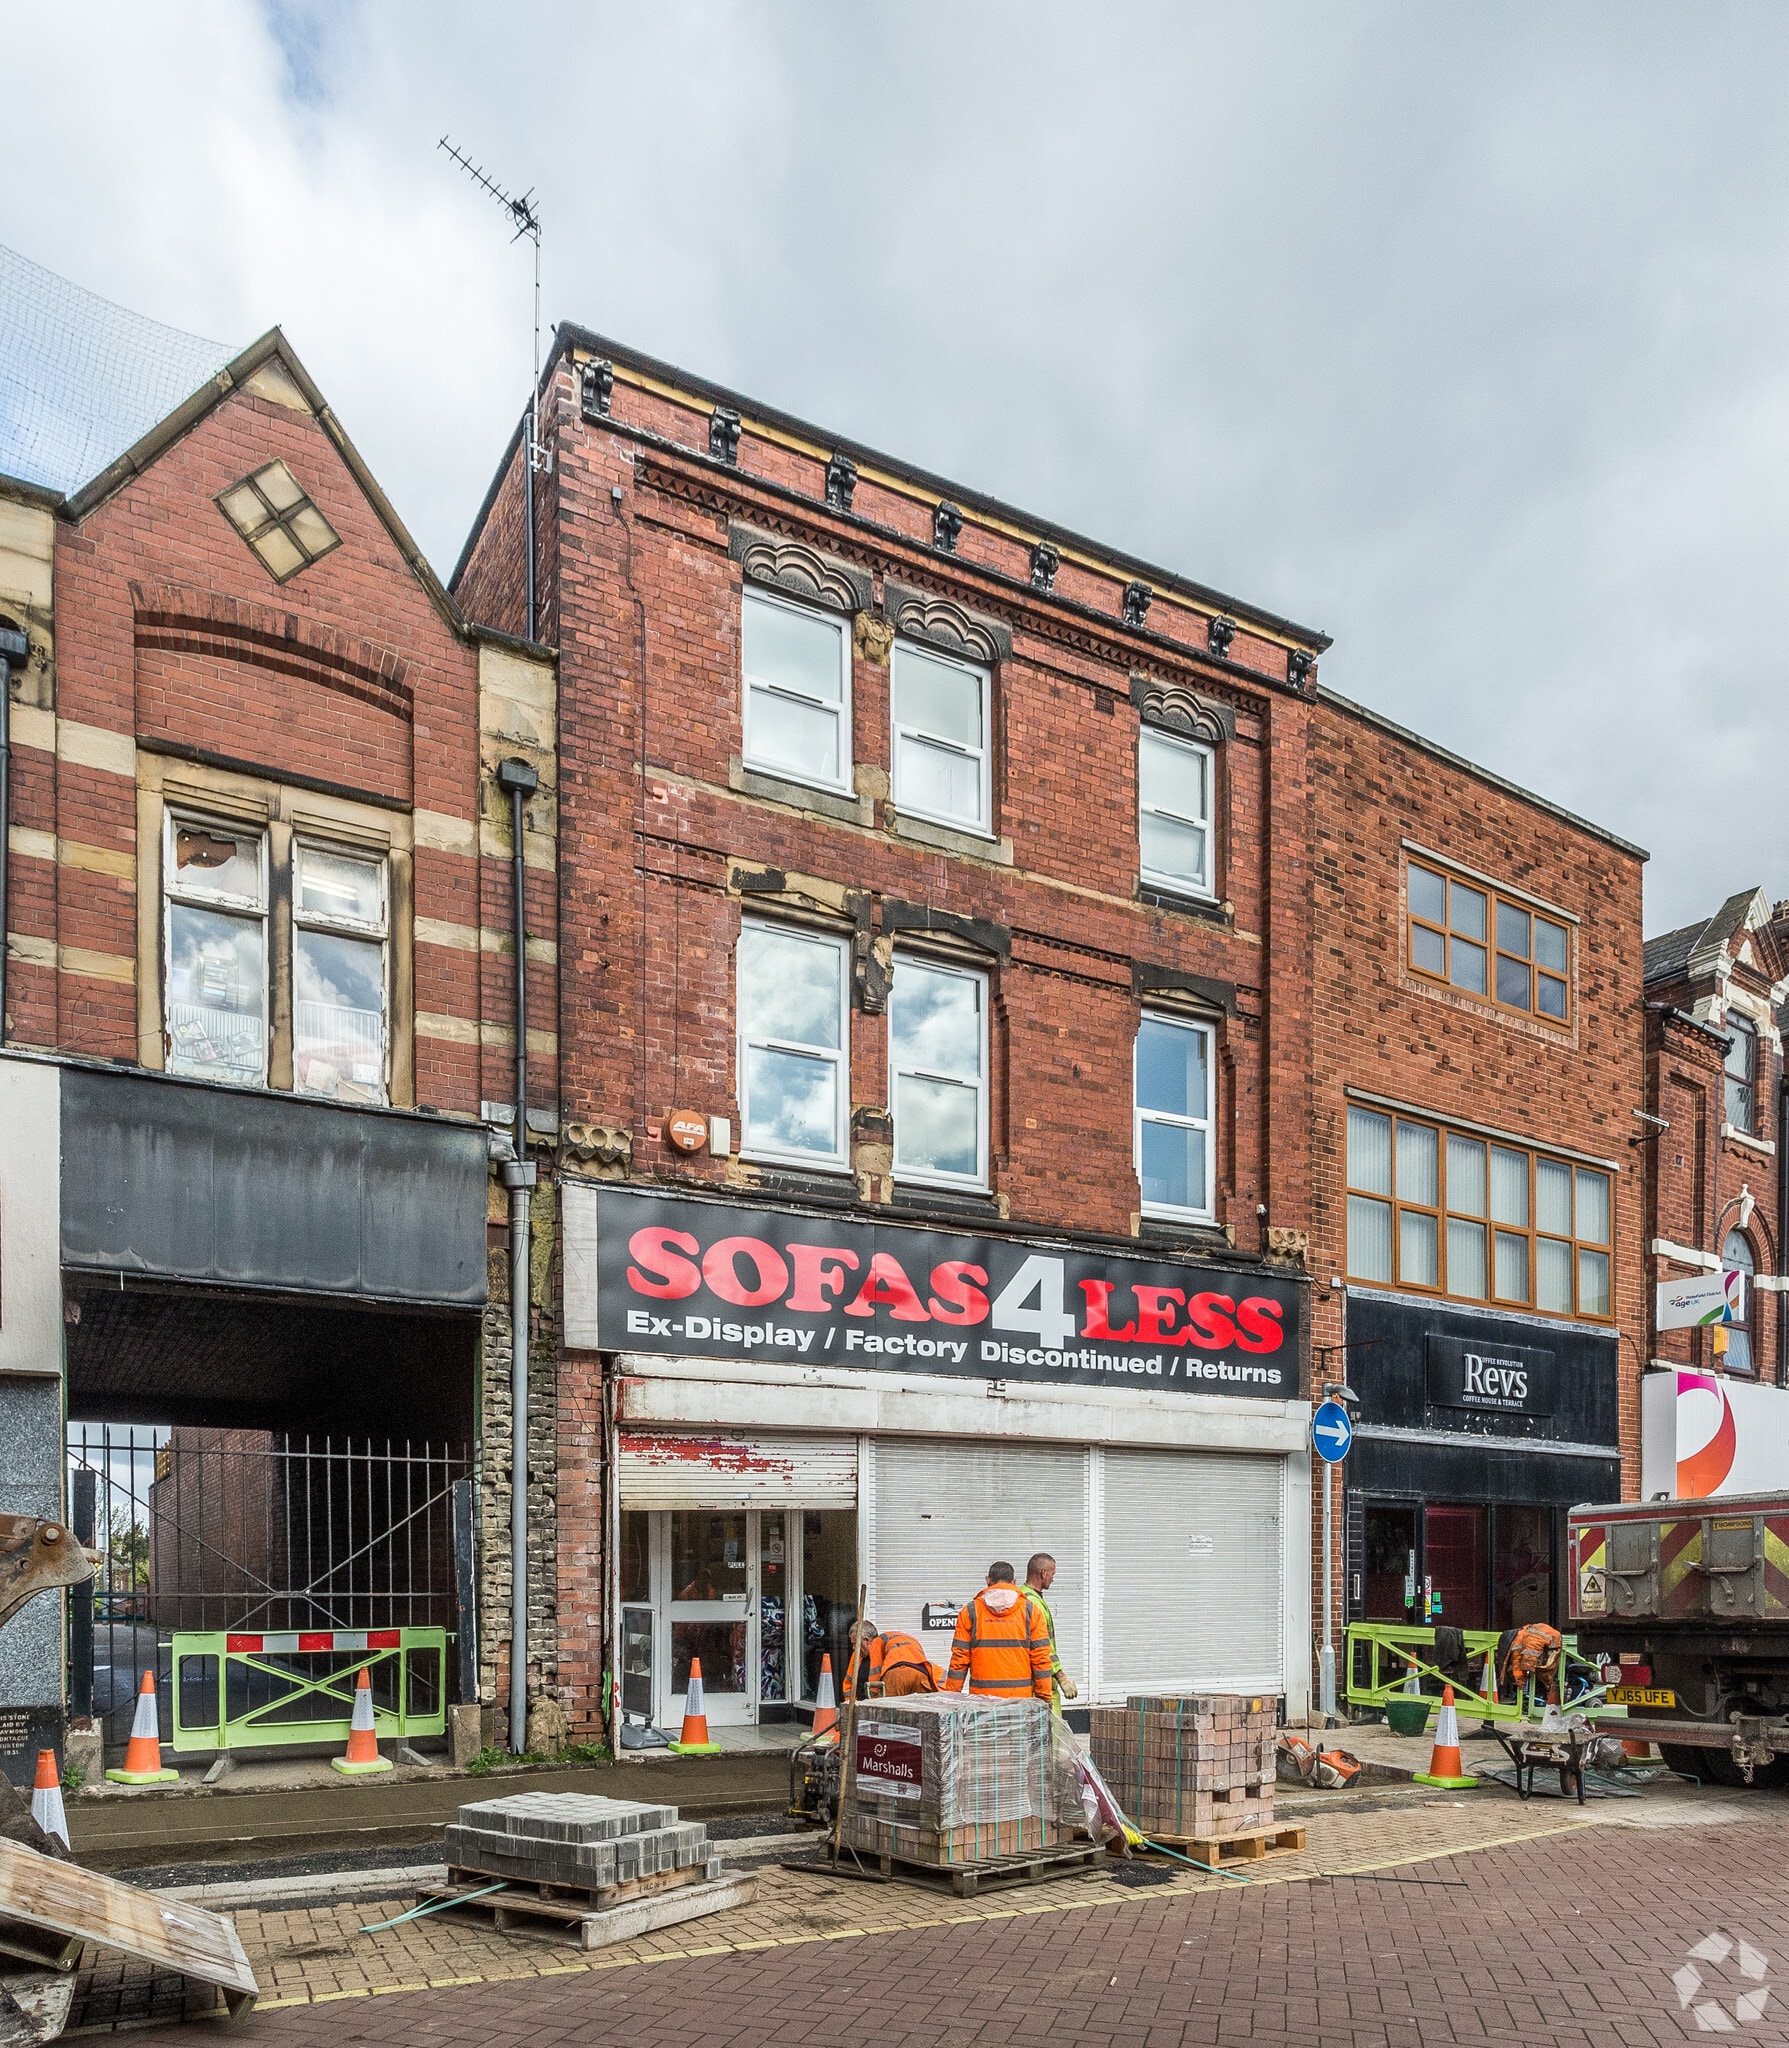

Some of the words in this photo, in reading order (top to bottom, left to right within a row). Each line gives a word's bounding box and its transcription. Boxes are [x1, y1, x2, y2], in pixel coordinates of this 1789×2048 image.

[673, 1120, 704, 1132] AFA
[1675, 1299, 1690, 1309] age
[627, 1309, 816, 1352] Ex-Display
[823, 1327, 836, 1350] /
[845, 1329, 968, 1363] Factory
[981, 1340, 1163, 1375] Discontinued
[1169, 1356, 1180, 1376] /
[1186, 1358, 1282, 1385] Returns
[1496, 1358, 1523, 1369] REVOLUTION
[1463, 1353, 1528, 1399] Revs
[1462, 1394, 1481, 1404] COFFEE
[1481, 1396, 1497, 1406] HOUSE
[1502, 1399, 1524, 1408] TERRACE
[1611, 1689, 1642, 1702] YJ65
[1644, 1691, 1670, 1704] UFE
[862, 1756, 914, 1779] Marshalls
